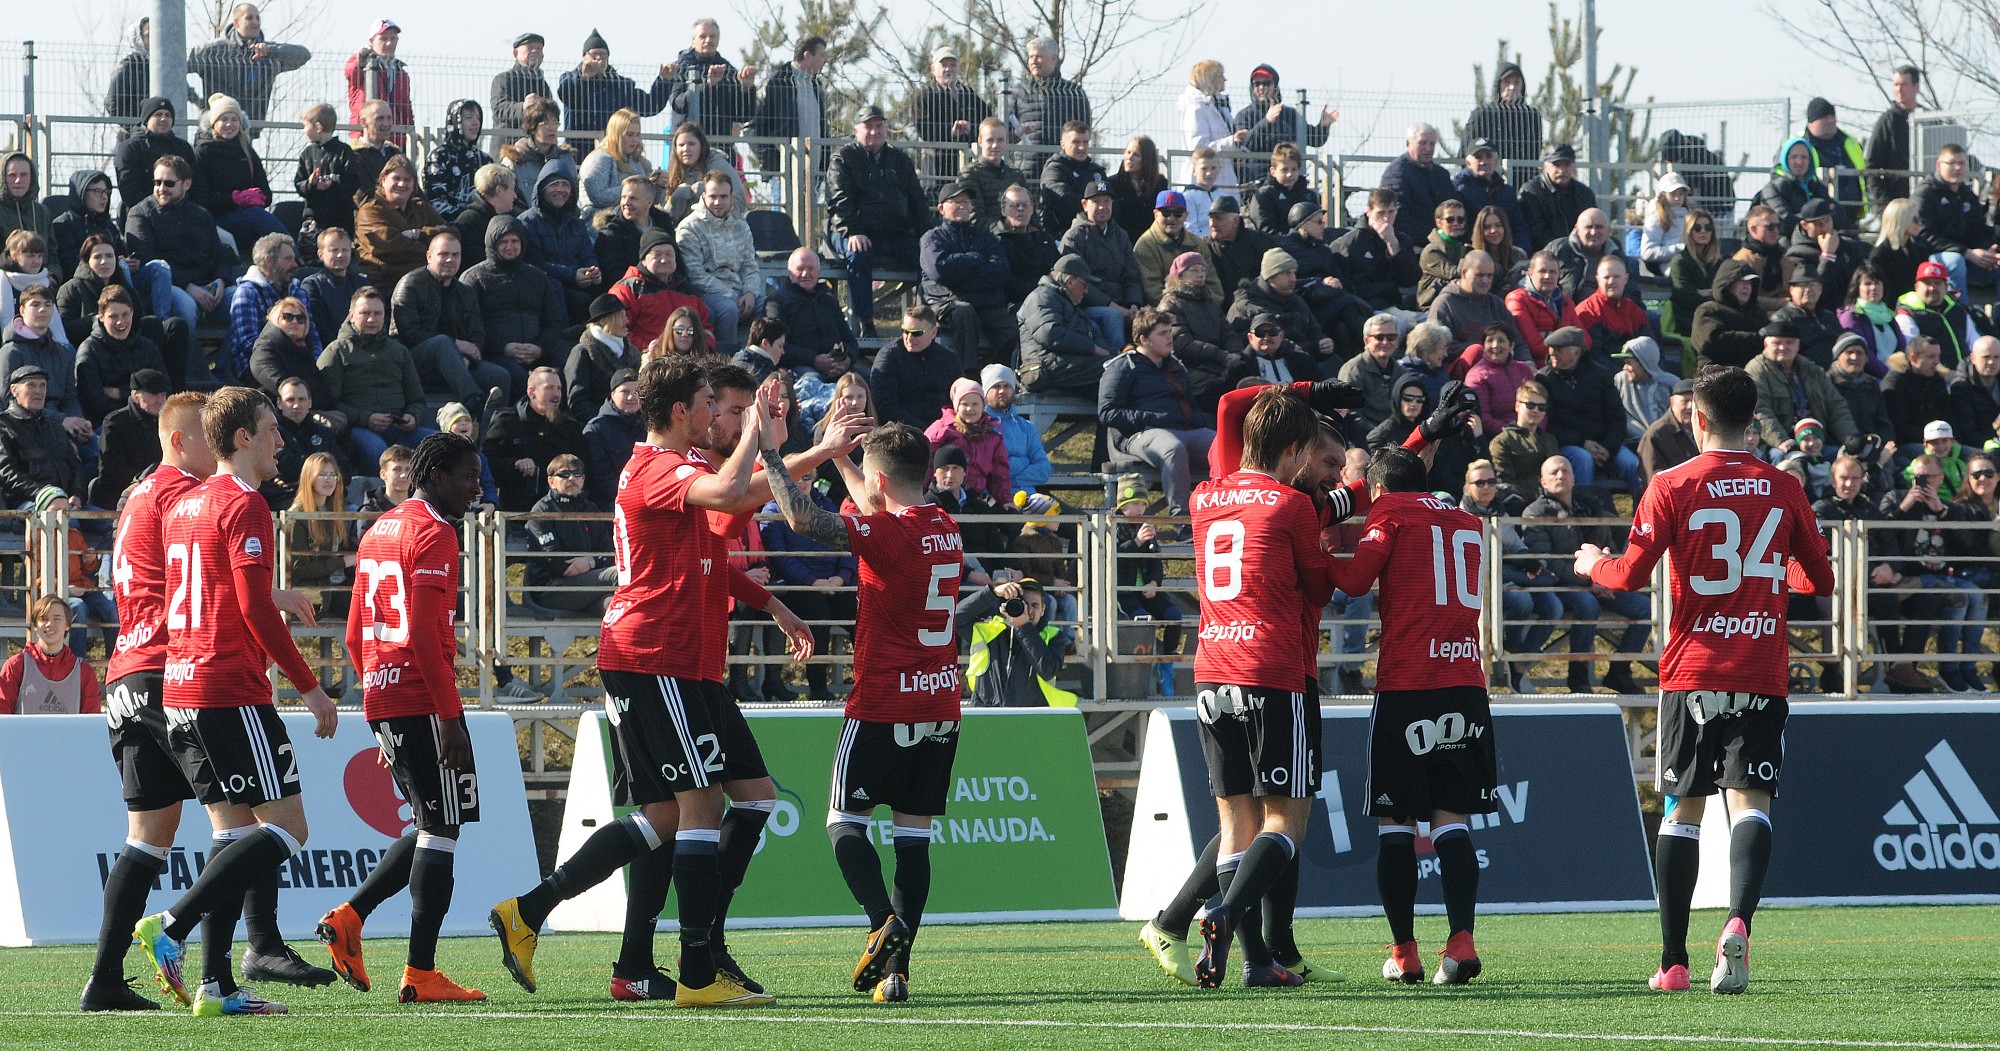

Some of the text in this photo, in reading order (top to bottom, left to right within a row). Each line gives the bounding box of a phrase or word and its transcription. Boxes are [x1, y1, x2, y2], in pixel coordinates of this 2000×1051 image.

[370, 519, 402, 537] KEITA
[1707, 479, 1771, 498] NEGRO
[113, 514, 133, 596] 4
[167, 543, 202, 630] 21
[1205, 520, 1245, 602] 8
[1431, 525, 1483, 609] 10
[1689, 507, 1786, 595] 34
[359, 559, 408, 643] 33
[917, 563, 960, 647] 5
[696, 733, 724, 773] 2
[954, 776, 1037, 802] AUTO.
[949, 817, 1056, 844] NAUDA.
[1873, 822, 2000, 871] adida
